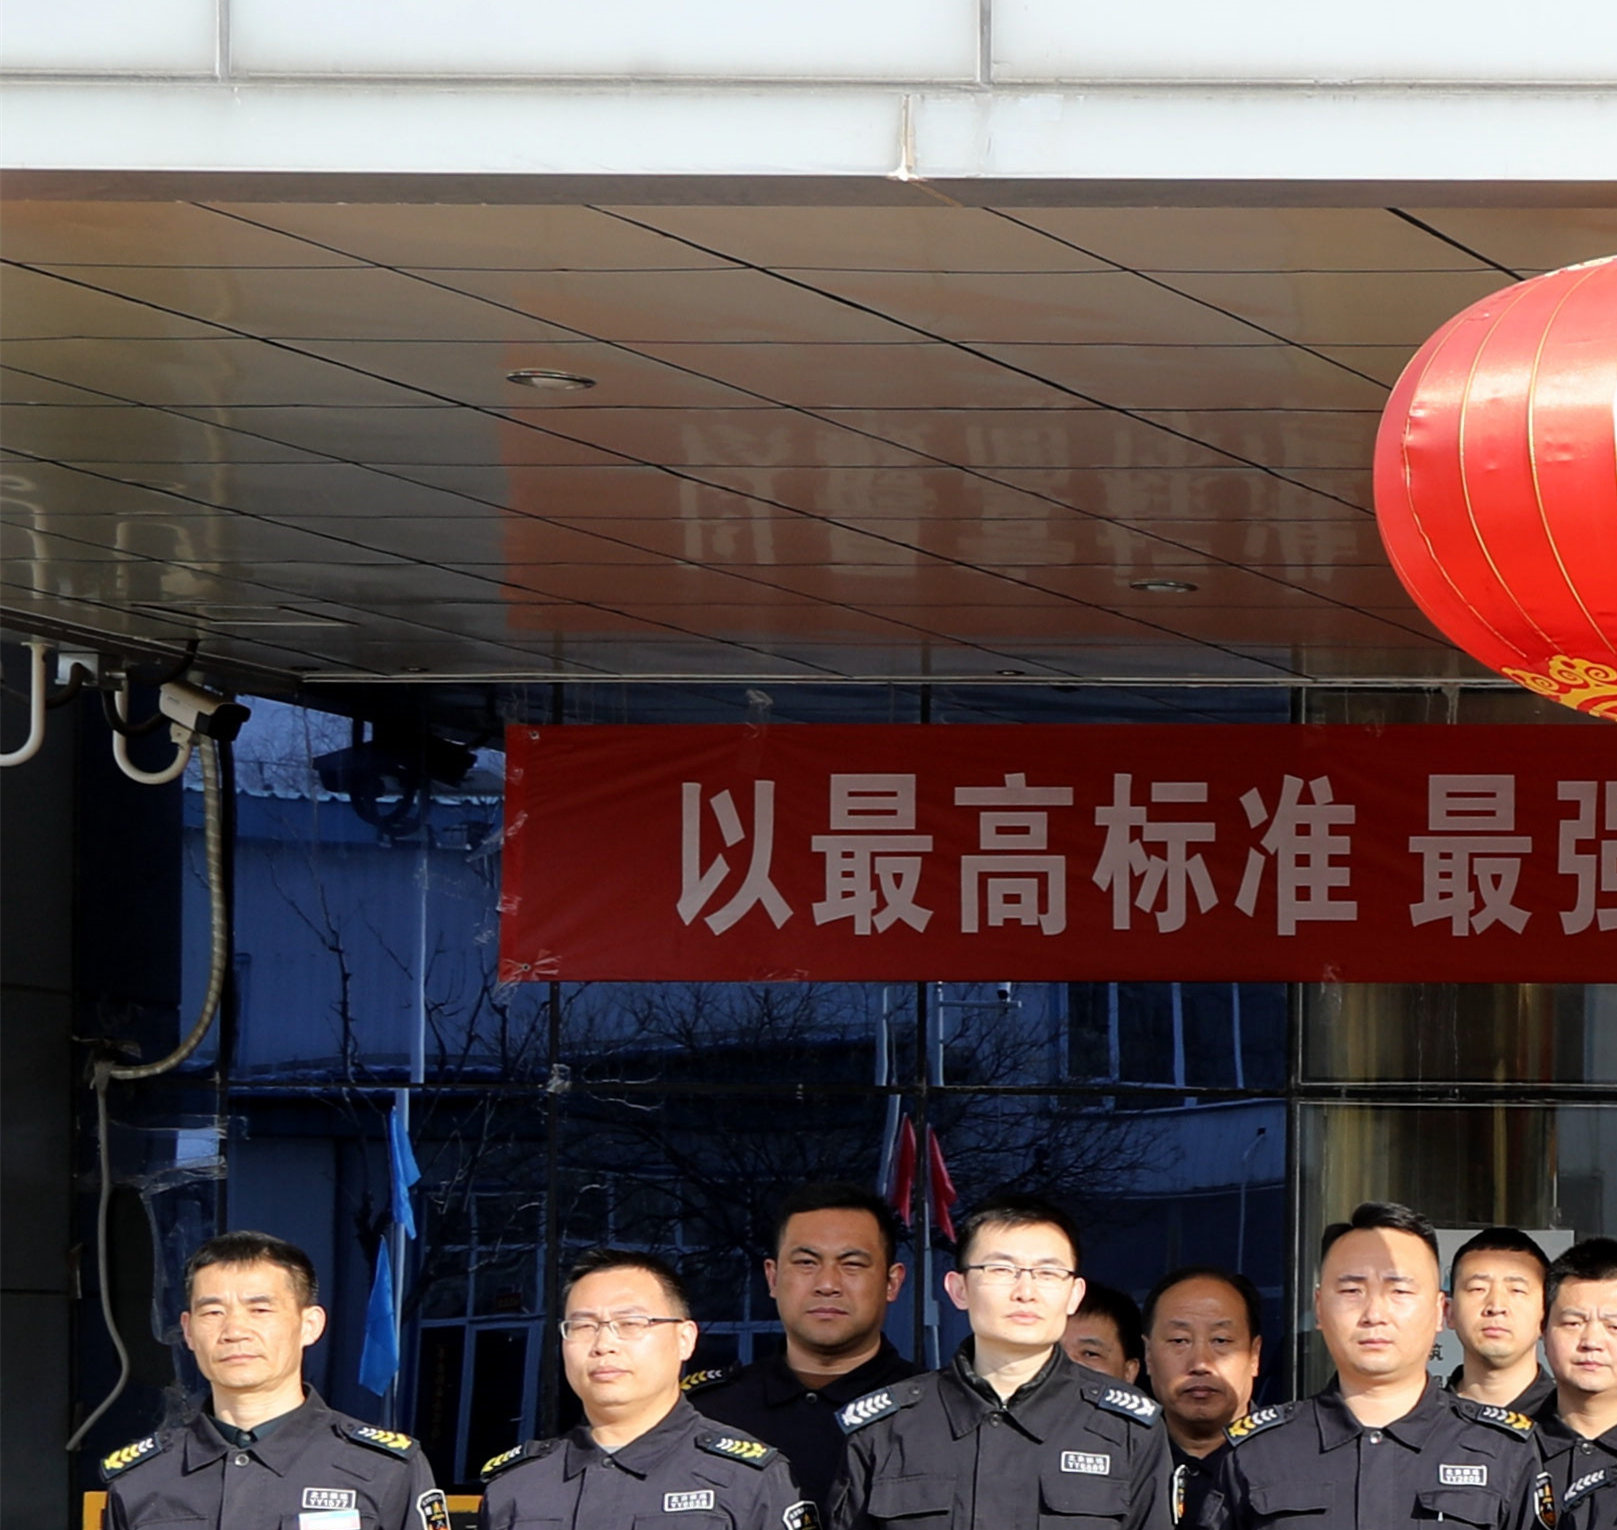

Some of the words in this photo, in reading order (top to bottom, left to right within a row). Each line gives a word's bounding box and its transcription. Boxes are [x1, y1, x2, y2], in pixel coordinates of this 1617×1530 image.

[675, 773, 1358, 937] 以最高标准
